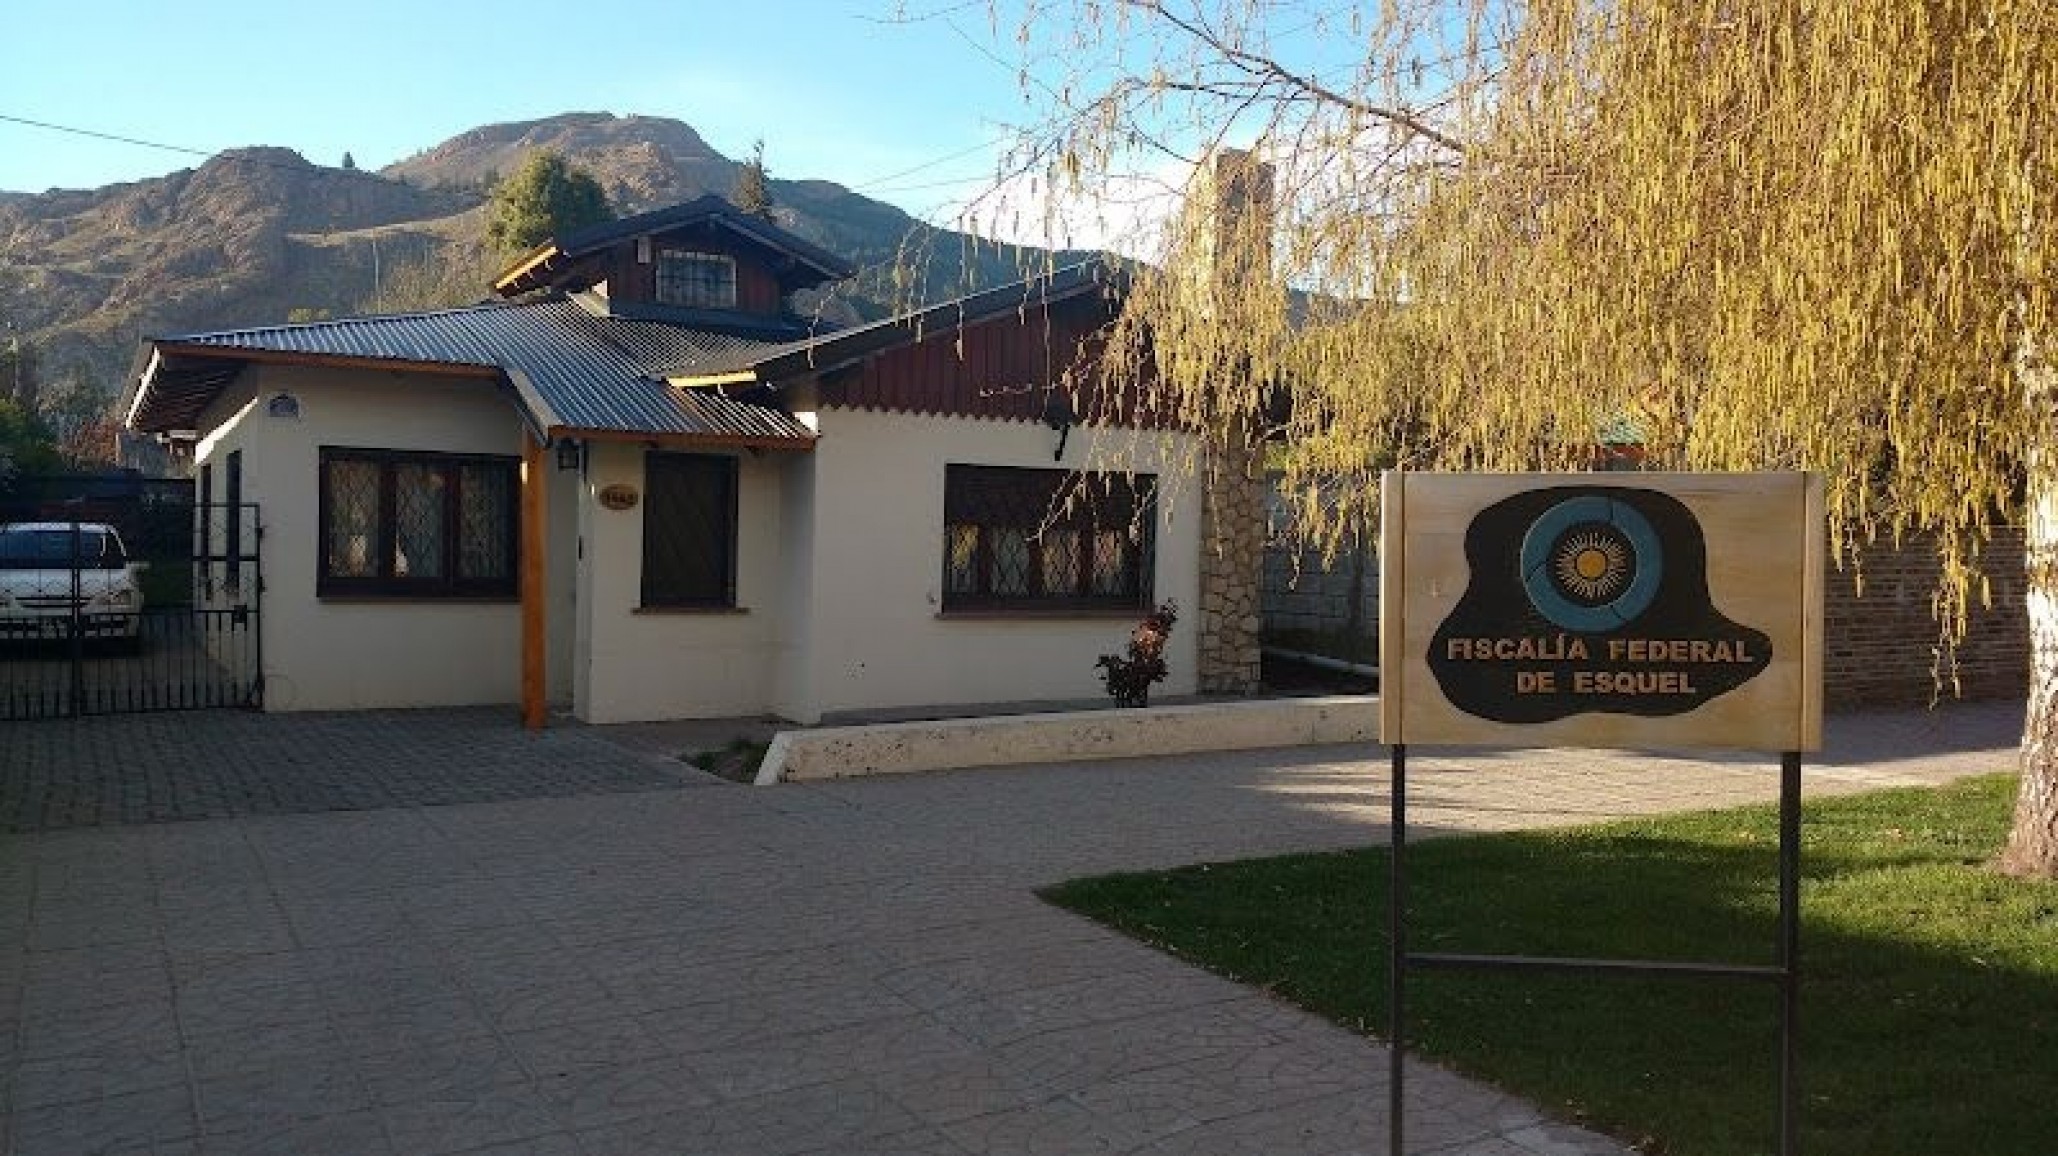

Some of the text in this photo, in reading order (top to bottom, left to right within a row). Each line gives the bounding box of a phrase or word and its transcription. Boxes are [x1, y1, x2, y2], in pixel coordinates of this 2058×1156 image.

[1447, 633, 1752, 662] FISCALÍA FEDERAL
[1517, 671, 1696, 695] DE ESQUEL
